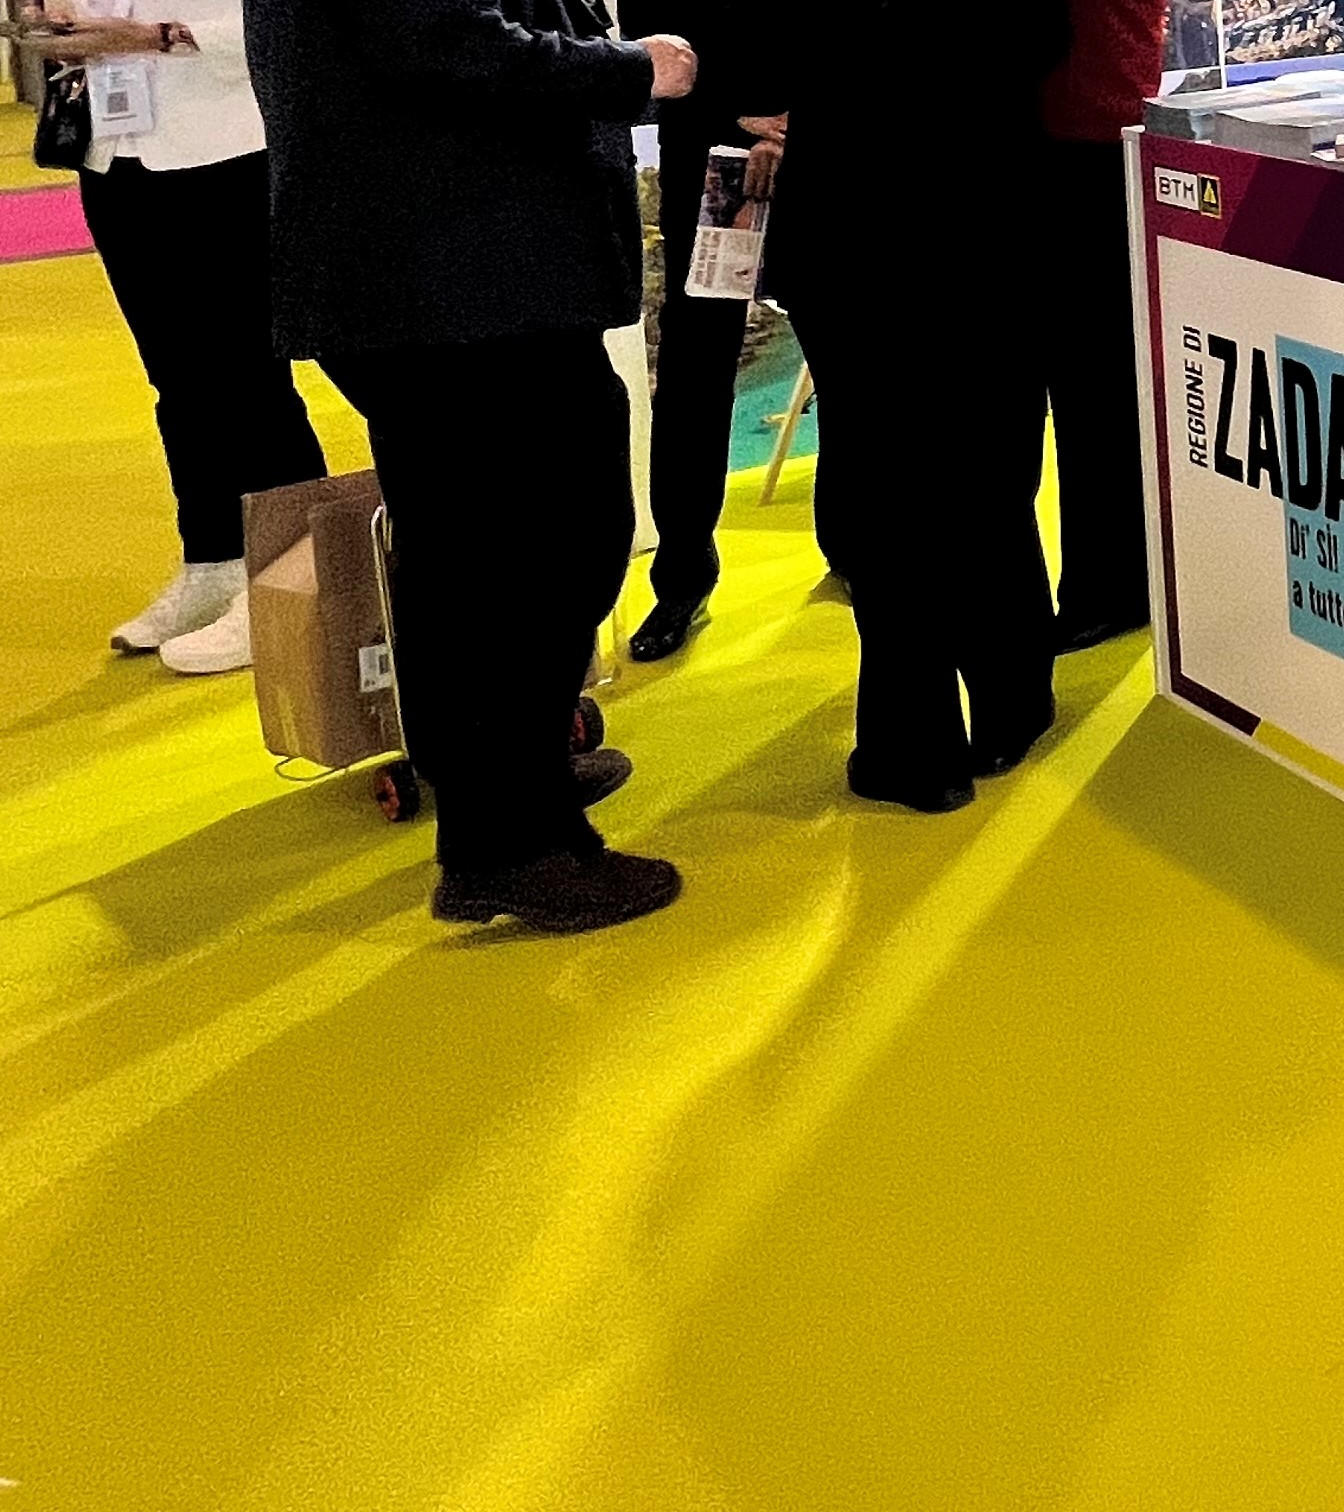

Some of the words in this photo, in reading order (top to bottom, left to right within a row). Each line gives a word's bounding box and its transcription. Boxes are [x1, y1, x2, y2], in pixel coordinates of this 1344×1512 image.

[1159, 176, 1196, 202] BTM
[1182, 325, 1202, 353] DI
[1183, 357, 1209, 468] REGIONE
[1292, 579, 1304, 608] a
